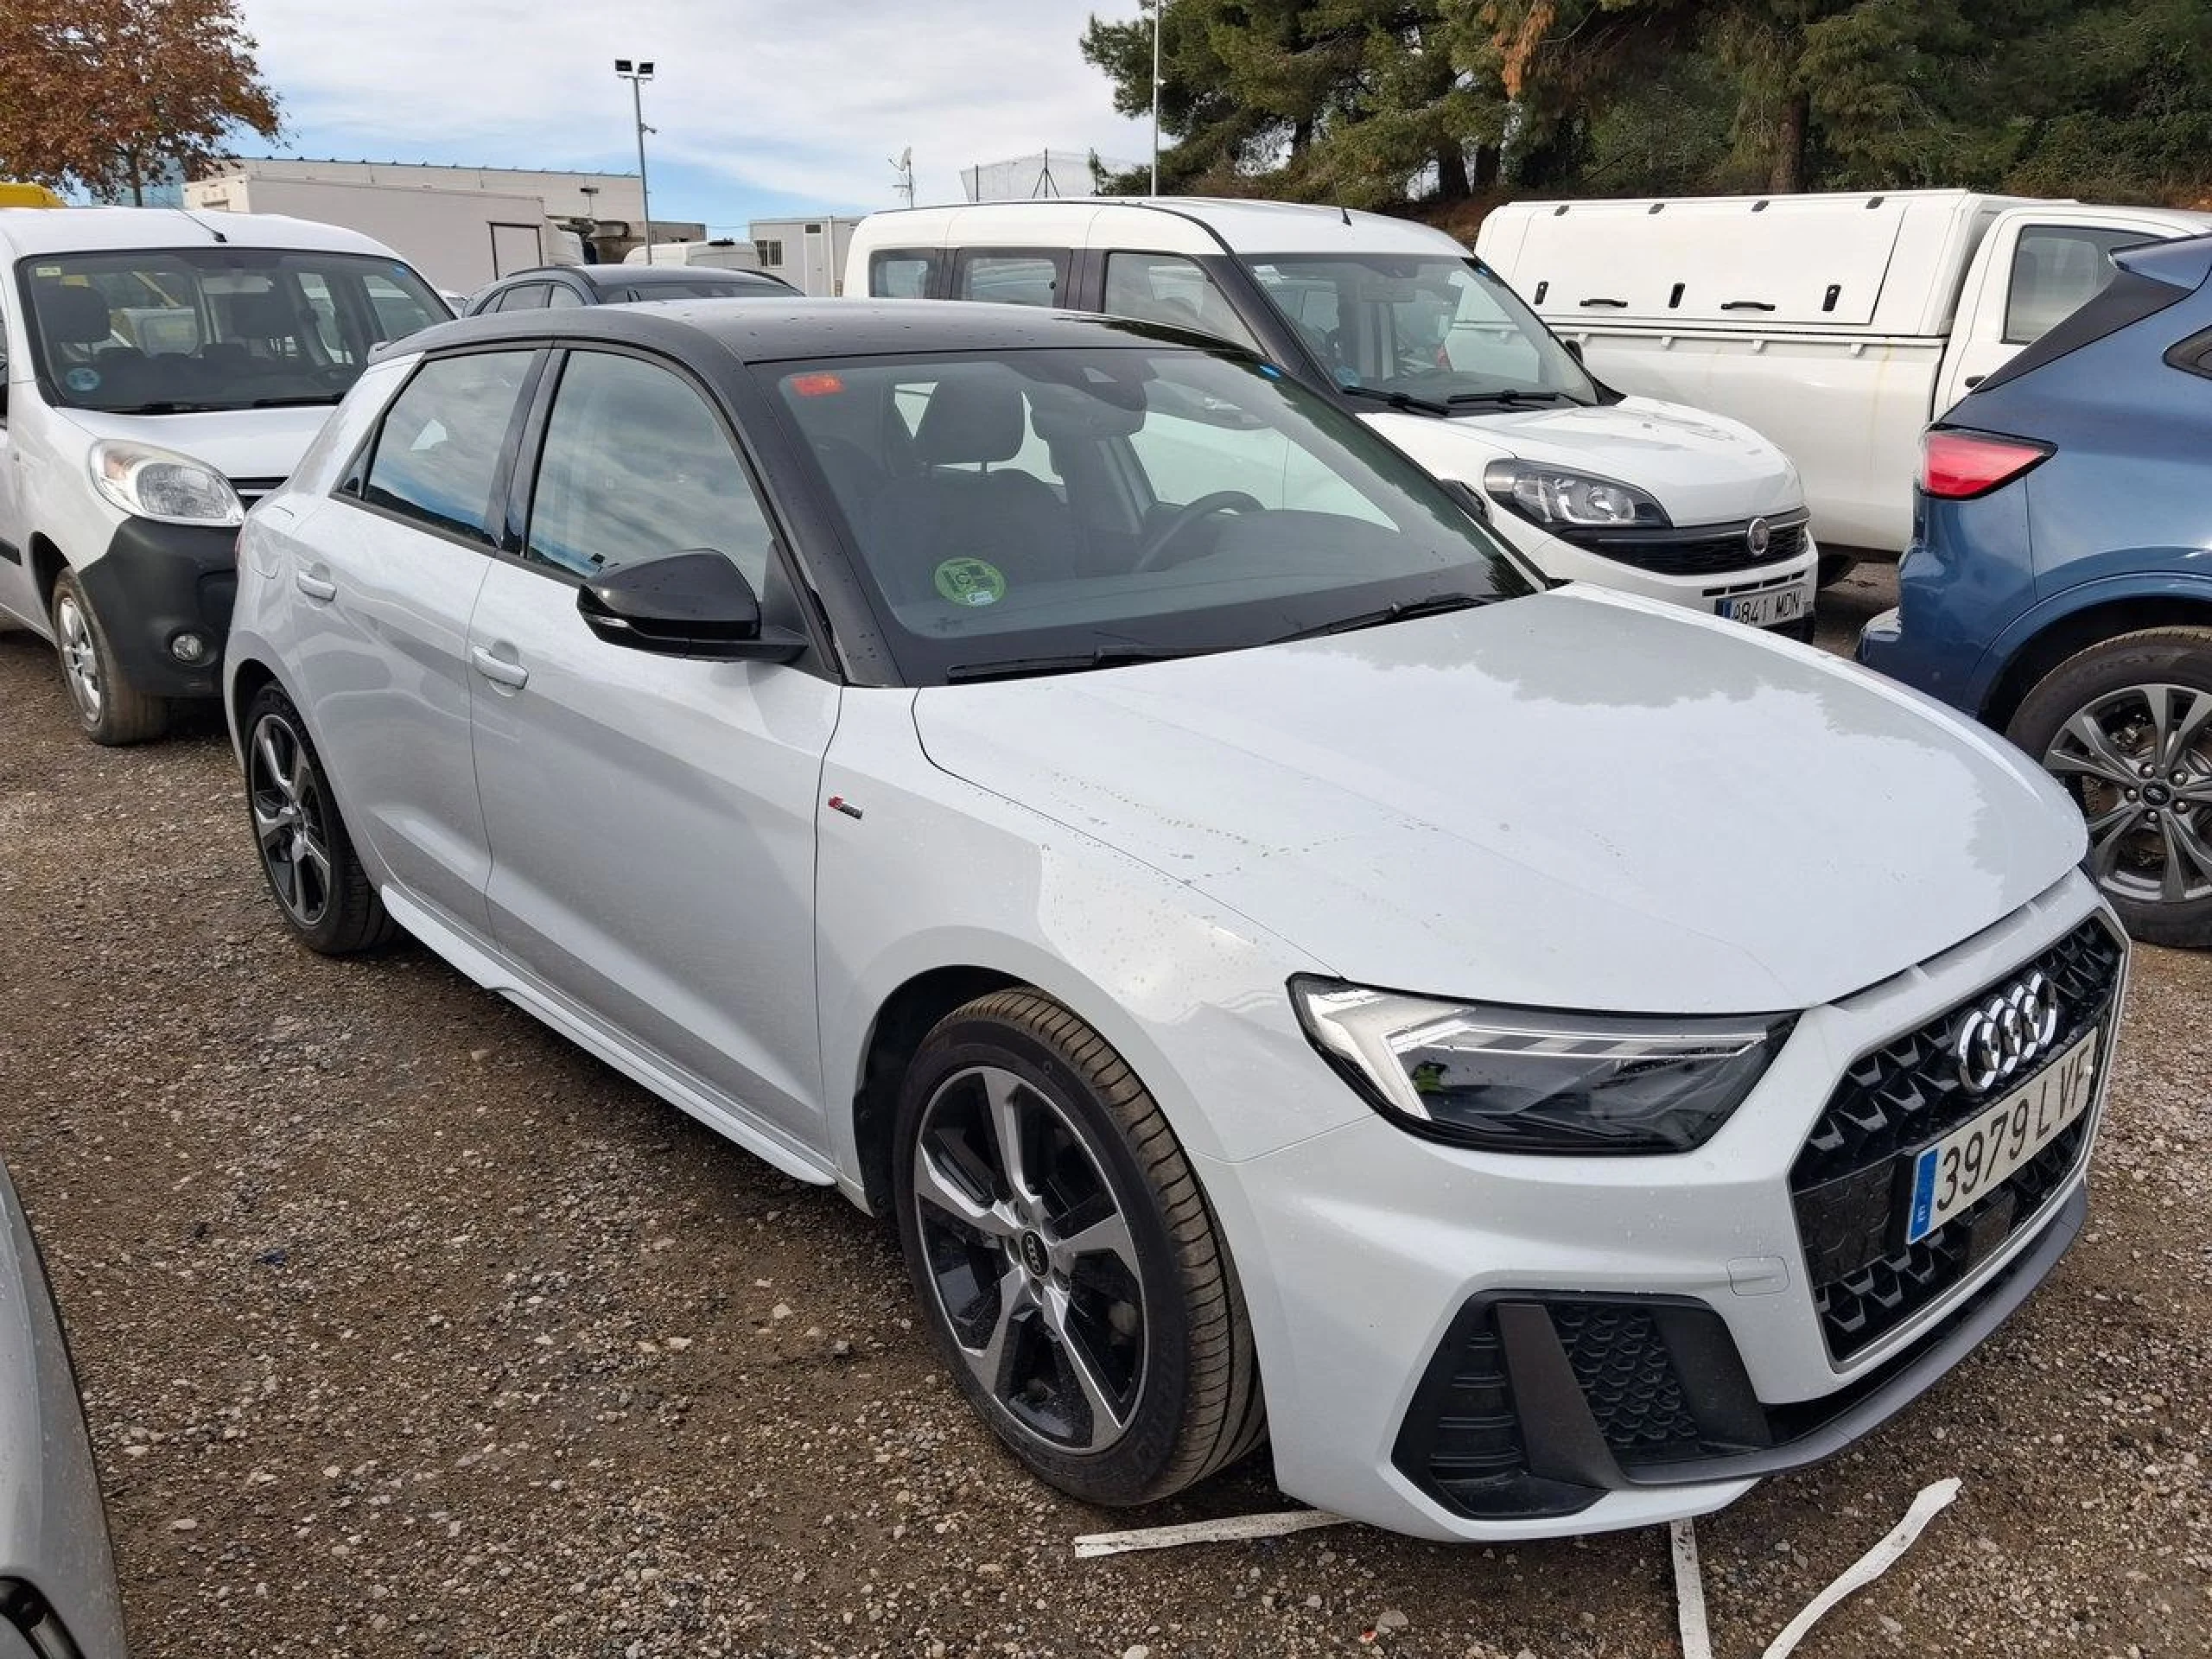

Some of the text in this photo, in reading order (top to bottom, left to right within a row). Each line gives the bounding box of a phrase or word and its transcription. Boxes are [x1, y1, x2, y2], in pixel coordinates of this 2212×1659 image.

[1937, 1043, 2090, 1213] 3979 LVF
[1916, 1205, 1927, 1224] E
